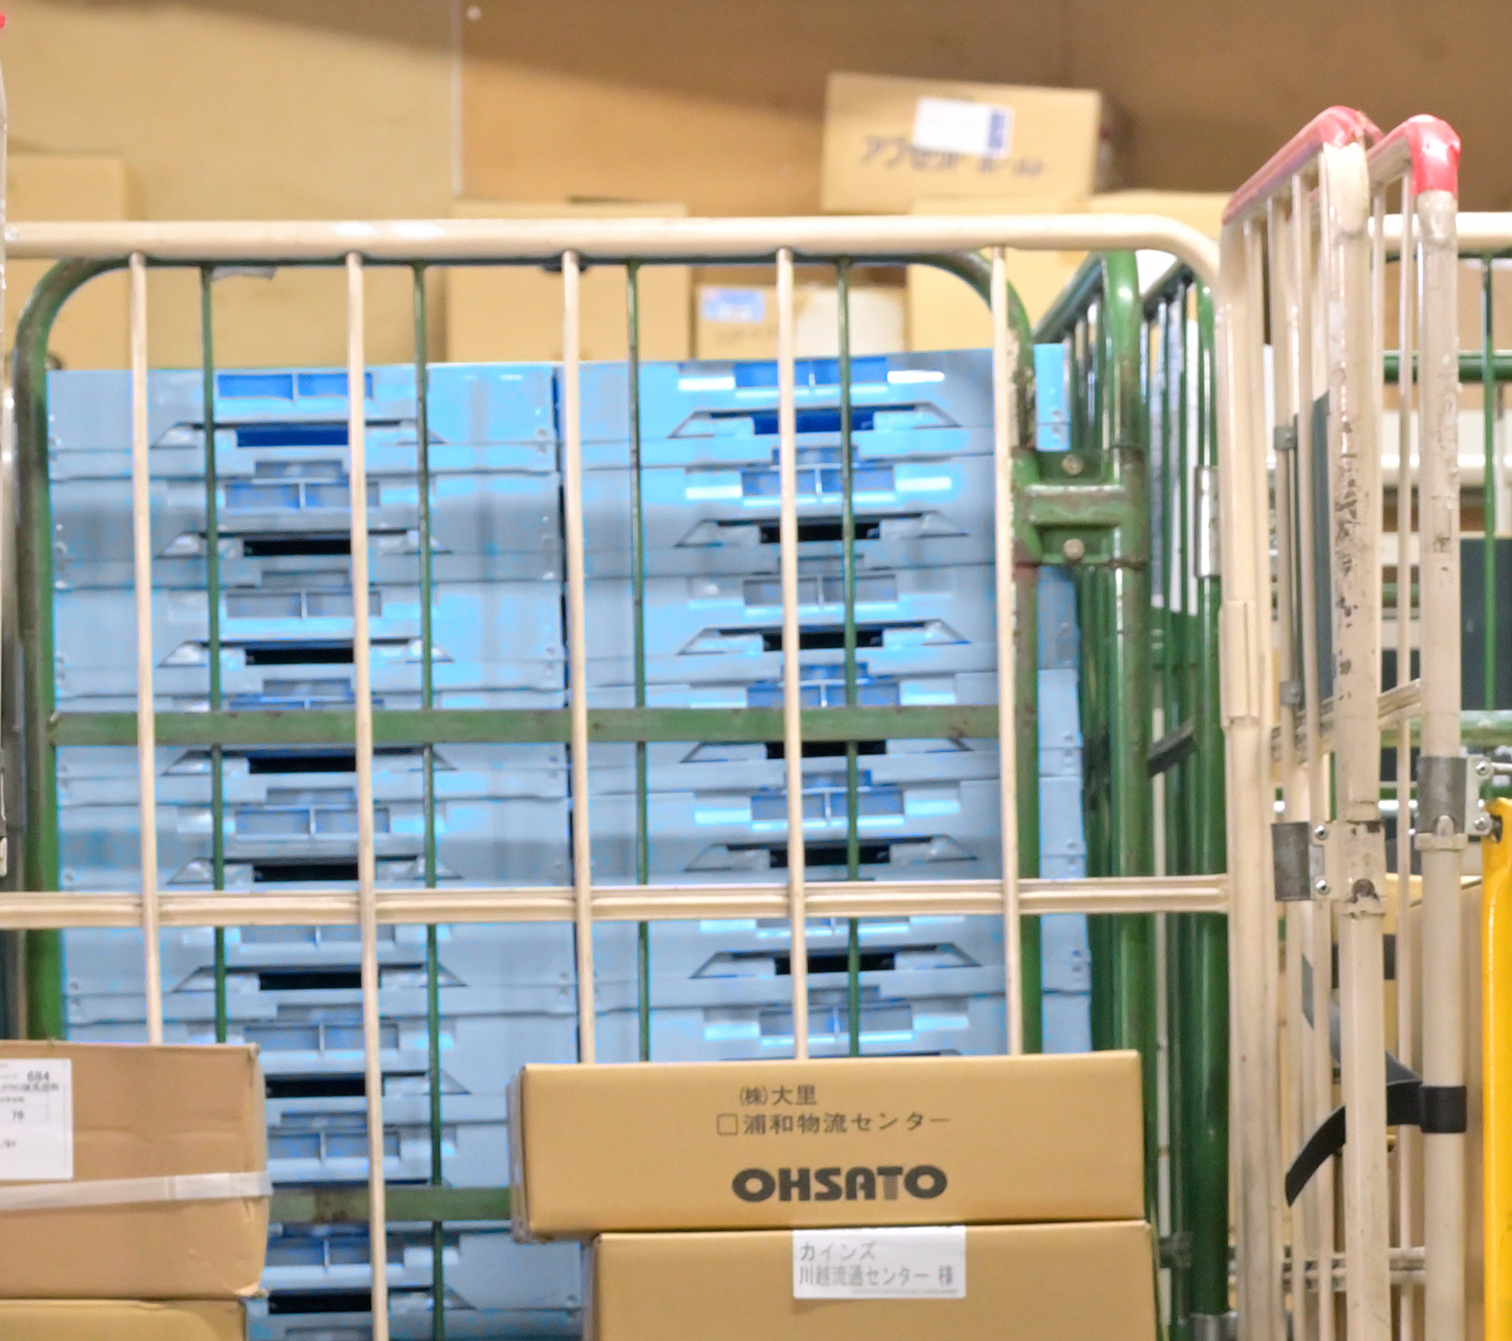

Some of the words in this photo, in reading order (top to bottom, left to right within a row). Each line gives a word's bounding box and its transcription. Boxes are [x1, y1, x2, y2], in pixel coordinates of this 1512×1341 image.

[739, 1084, 819, 1108] (株)大里
[744, 1110, 950, 1137] 浦和物流センター
[731, 1164, 948, 1203] OHSATO
[799, 1239, 876, 1262] カインズ
[798, 1264, 929, 1288] 川越流通センター
